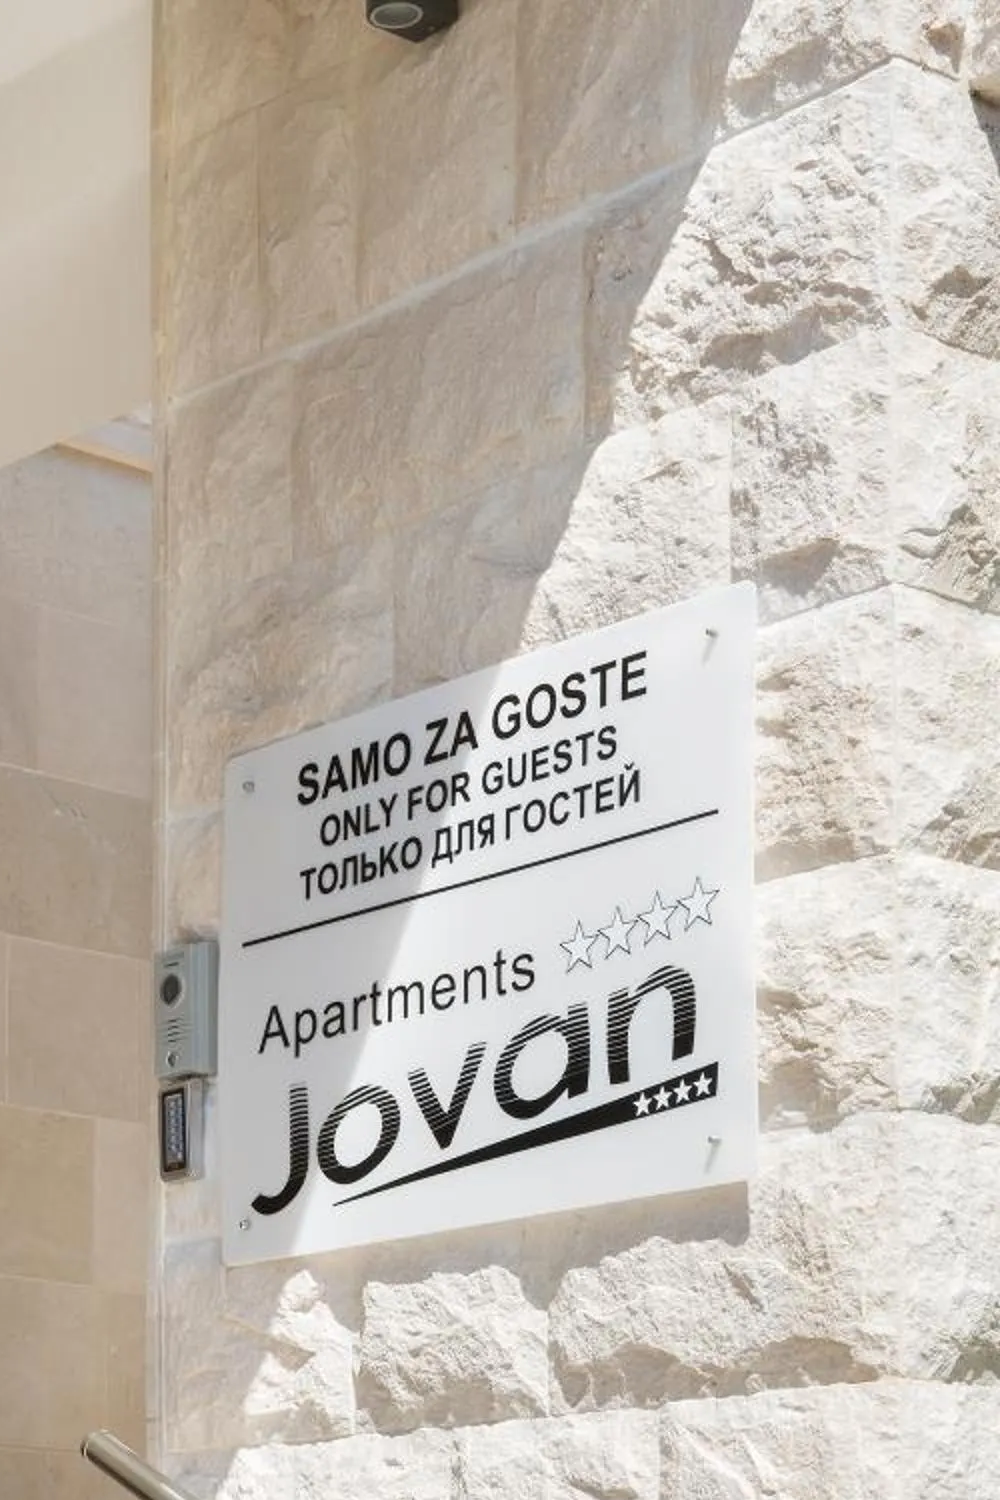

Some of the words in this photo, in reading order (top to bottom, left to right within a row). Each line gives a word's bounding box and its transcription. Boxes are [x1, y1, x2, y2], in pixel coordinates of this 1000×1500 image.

[297, 732, 412, 806] SAMO
[424, 711, 478, 765] ZA
[492, 650, 648, 740] GOSTE
[319, 793, 400, 847] ONLY
[407, 771, 471, 821] FOR
[481, 725, 618, 796] GUESTS
[299, 836, 423, 900] ТОЛЬКО
[431, 813, 495, 868] ДЛЯ
[505, 763, 641, 841] ГОСТЕЙ
[258, 949, 536, 1058] Apartments
